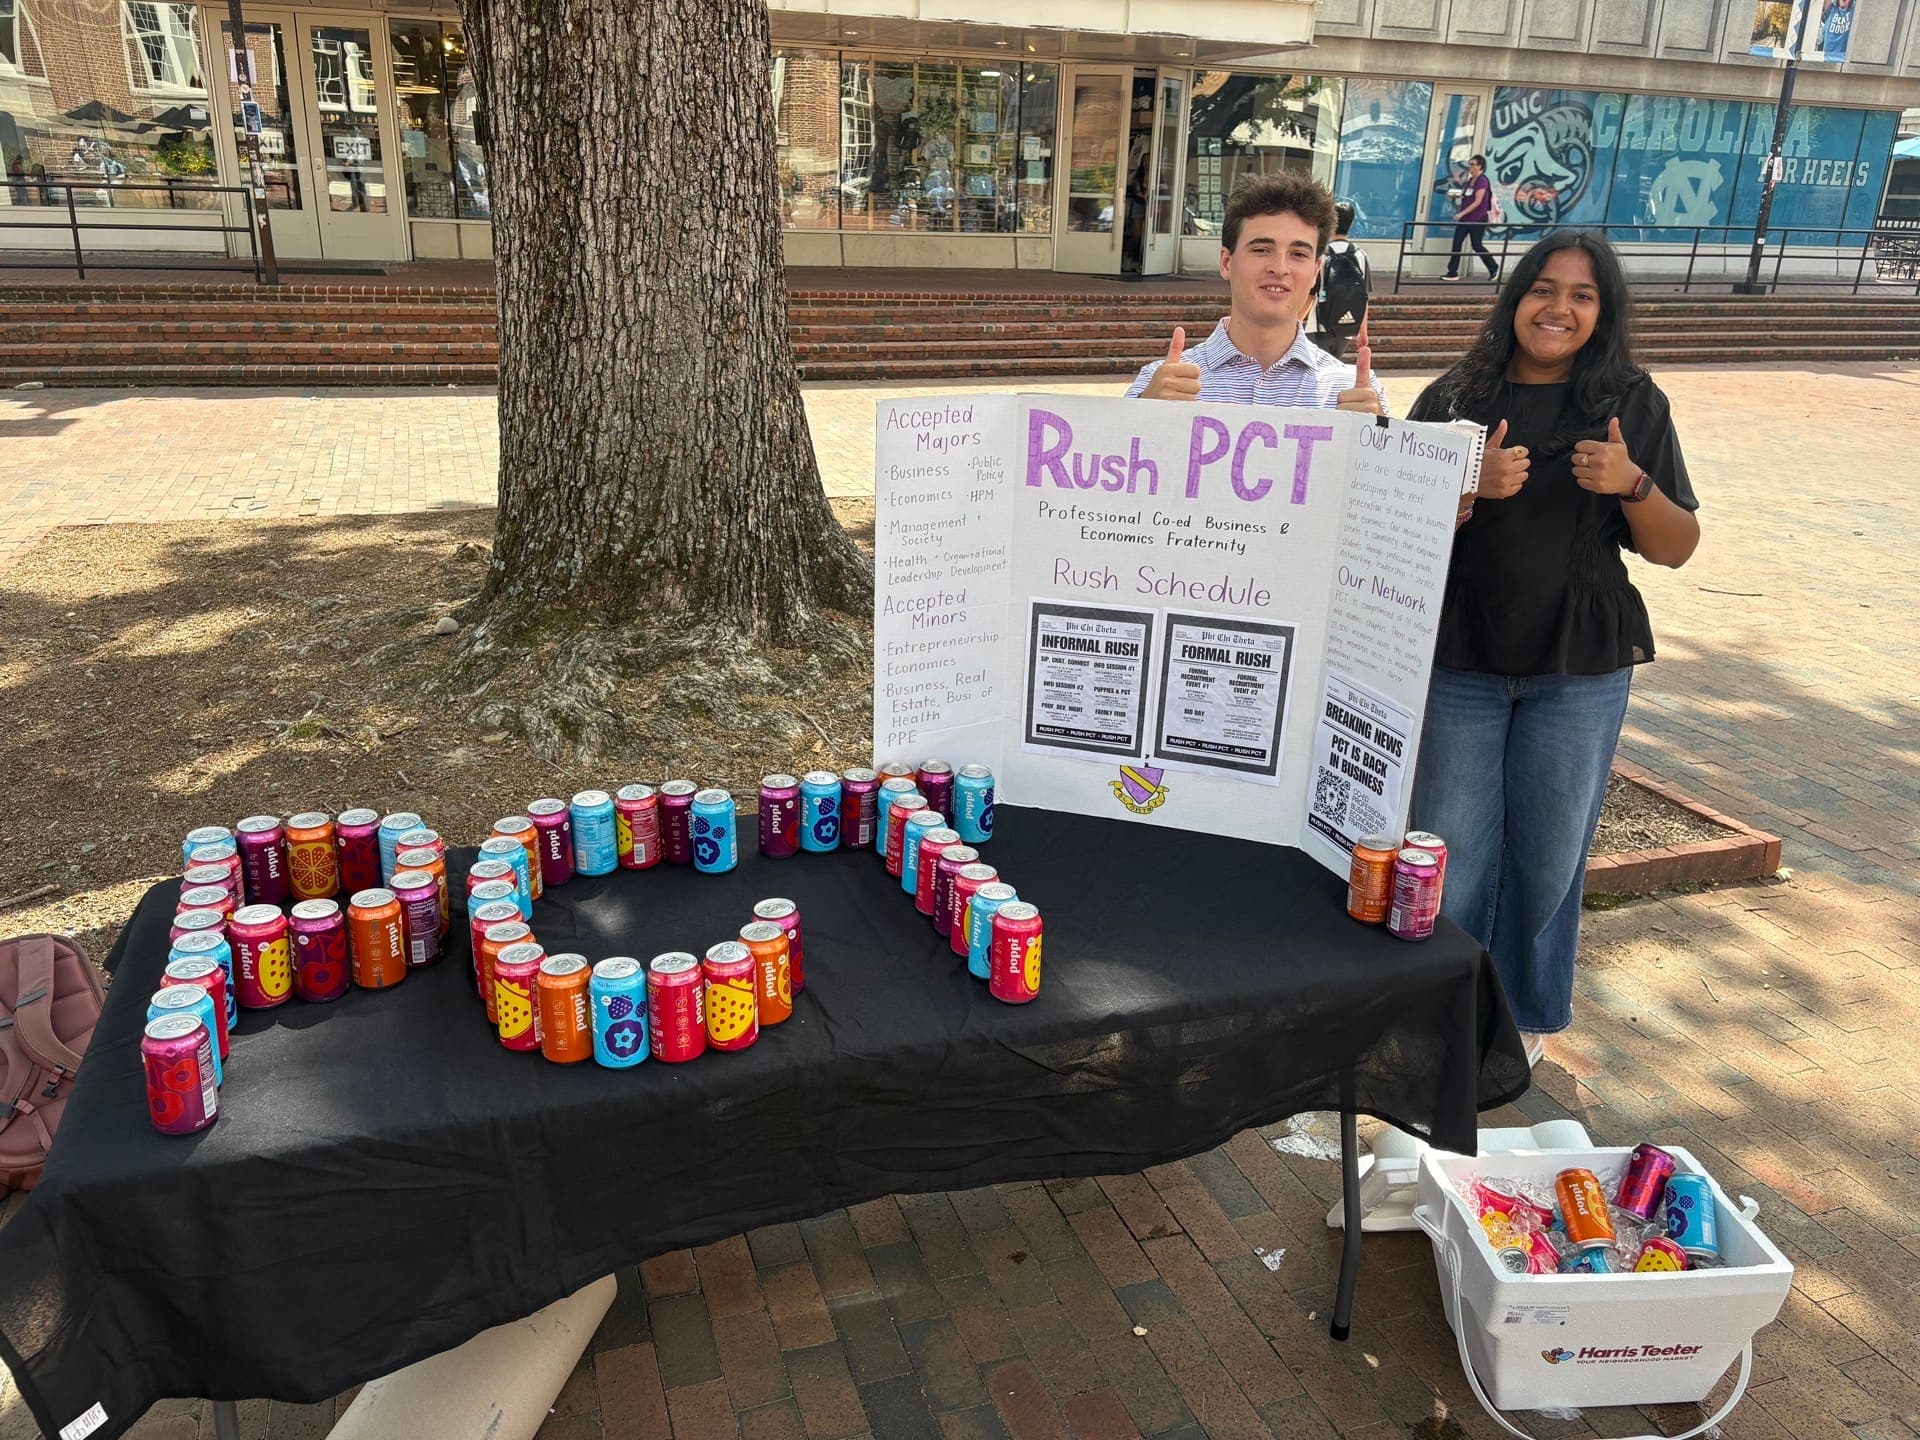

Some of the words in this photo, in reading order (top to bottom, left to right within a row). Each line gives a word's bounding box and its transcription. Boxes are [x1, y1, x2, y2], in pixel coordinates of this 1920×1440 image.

[1495, 91, 1544, 129] UNC
[1590, 92, 1812, 158] CAROLINA
[335, 140, 370, 157] EXIT
[1757, 156, 1798, 184] TR
[1801, 158, 1870, 187] HEELS
[886, 404, 974, 430] Accepted
[916, 431, 982, 455] Majors
[1360, 424, 1393, 449] Our
[1400, 431, 1458, 466] Mission
[972, 456, 1002, 470] Public
[1025, 408, 1159, 496] Rush
[1185, 415, 1334, 505] PCT
[890, 464, 950, 481] Business
[976, 467, 1004, 483] Policy
[1355, 457, 1369, 472] We
[1375, 464, 1389, 477] are
[1396, 466, 1437, 487] dedicated
[1442, 477, 1450, 490] to
[890, 490, 953, 507] Economics
[970, 489, 994, 503] HPM
[1350, 477, 1387, 500] developing
[1394, 487, 1405, 500] the
[890, 512, 967, 535] Management
[1038, 500, 1141, 526] Professional
[1152, 510, 1192, 528] Co-ed
[1206, 516, 1267, 534] Business
[1279, 522, 1290, 535] &
[902, 533, 943, 547] Society
[1080, 526, 1154, 546] Economics
[1167, 531, 1246, 556] Fraternity
[889, 555, 928, 569] Health
[950, 558, 1009, 577] Development
[888, 569, 943, 586] Leadership
[1053, 557, 1118, 591] Rush
[1136, 565, 1271, 607] Schedule
[1338, 565, 1367, 589] Our
[1371, 575, 1426, 615] Network
[883, 588, 967, 617] Accepted
[911, 610, 968, 631] Minors
[1066, 621, 1079, 631] Phi
[1081, 623, 1094, 633] Chi
[1095, 624, 1117, 634] Theta
[887, 632, 1000, 656] Entrepreneurship
[1041, 634, 1101, 654] INFORMAL
[1105, 640, 1139, 657] RUSH
[1201, 631, 1215, 641] Phi
[1217, 632, 1231, 642] Chi
[1232, 634, 1255, 645] Theta
[887, 658, 957, 677] Economics
[1106, 663, 1127, 671] SESSION
[1181, 644, 1231, 664] FORMAL
[1235, 652, 1272, 668] RUSH
[955, 669, 986, 687] Real
[1055, 682, 1076, 690] SESSION
[1181, 673, 1215, 683] RECRUITMENT
[1186, 680, 1201, 689] EVENT
[1229, 680, 1264, 690] RECRUITMENT
[947, 690, 972, 705] Busi
[981, 686, 993, 698] of
[1233, 687, 1249, 695] EVENT
[1250, 688, 1259, 696] #2
[1348, 690, 1359, 704] Phi
[1359, 695, 1370, 710] Chi
[1370, 702, 1388, 719] Theta
[892, 710, 941, 729] Health
[1325, 701, 1372, 740] BREAKING
[1374, 727, 1403, 758] NEWS
[888, 729, 918, 748] PPE
[1185, 739, 1197, 747] PCT
[1217, 744, 1229, 752] PCT
[1250, 749, 1263, 757] PCT
[1331, 734, 1350, 756] PCT
[1351, 744, 1361, 762] IS
[1362, 753, 1389, 779] BACK
[1329, 752, 1339, 770] IN
[1341, 760, 1384, 796] BUSINESS
[965, 790, 975, 820] poppi
[771, 803, 782, 834] poppi
[546, 829, 562, 861] poppi
[908, 838, 917, 870] poppi
[264, 846, 280, 879] poppi
[516, 863, 528, 897] poppi
[953, 891, 961, 928] poppi
[385, 921, 400, 958] poppi
[973, 910, 983, 948] poppi
[237, 942, 254, 980] poppi
[1007, 937, 1021, 974] poppi
[761, 961, 777, 998] poppi
[570, 993, 588, 1032] poppi
[1569, 1183, 1590, 1216] poppi
[1578, 1346, 1638, 1359] Harris
[1641, 1344, 1703, 1357] Teeter
